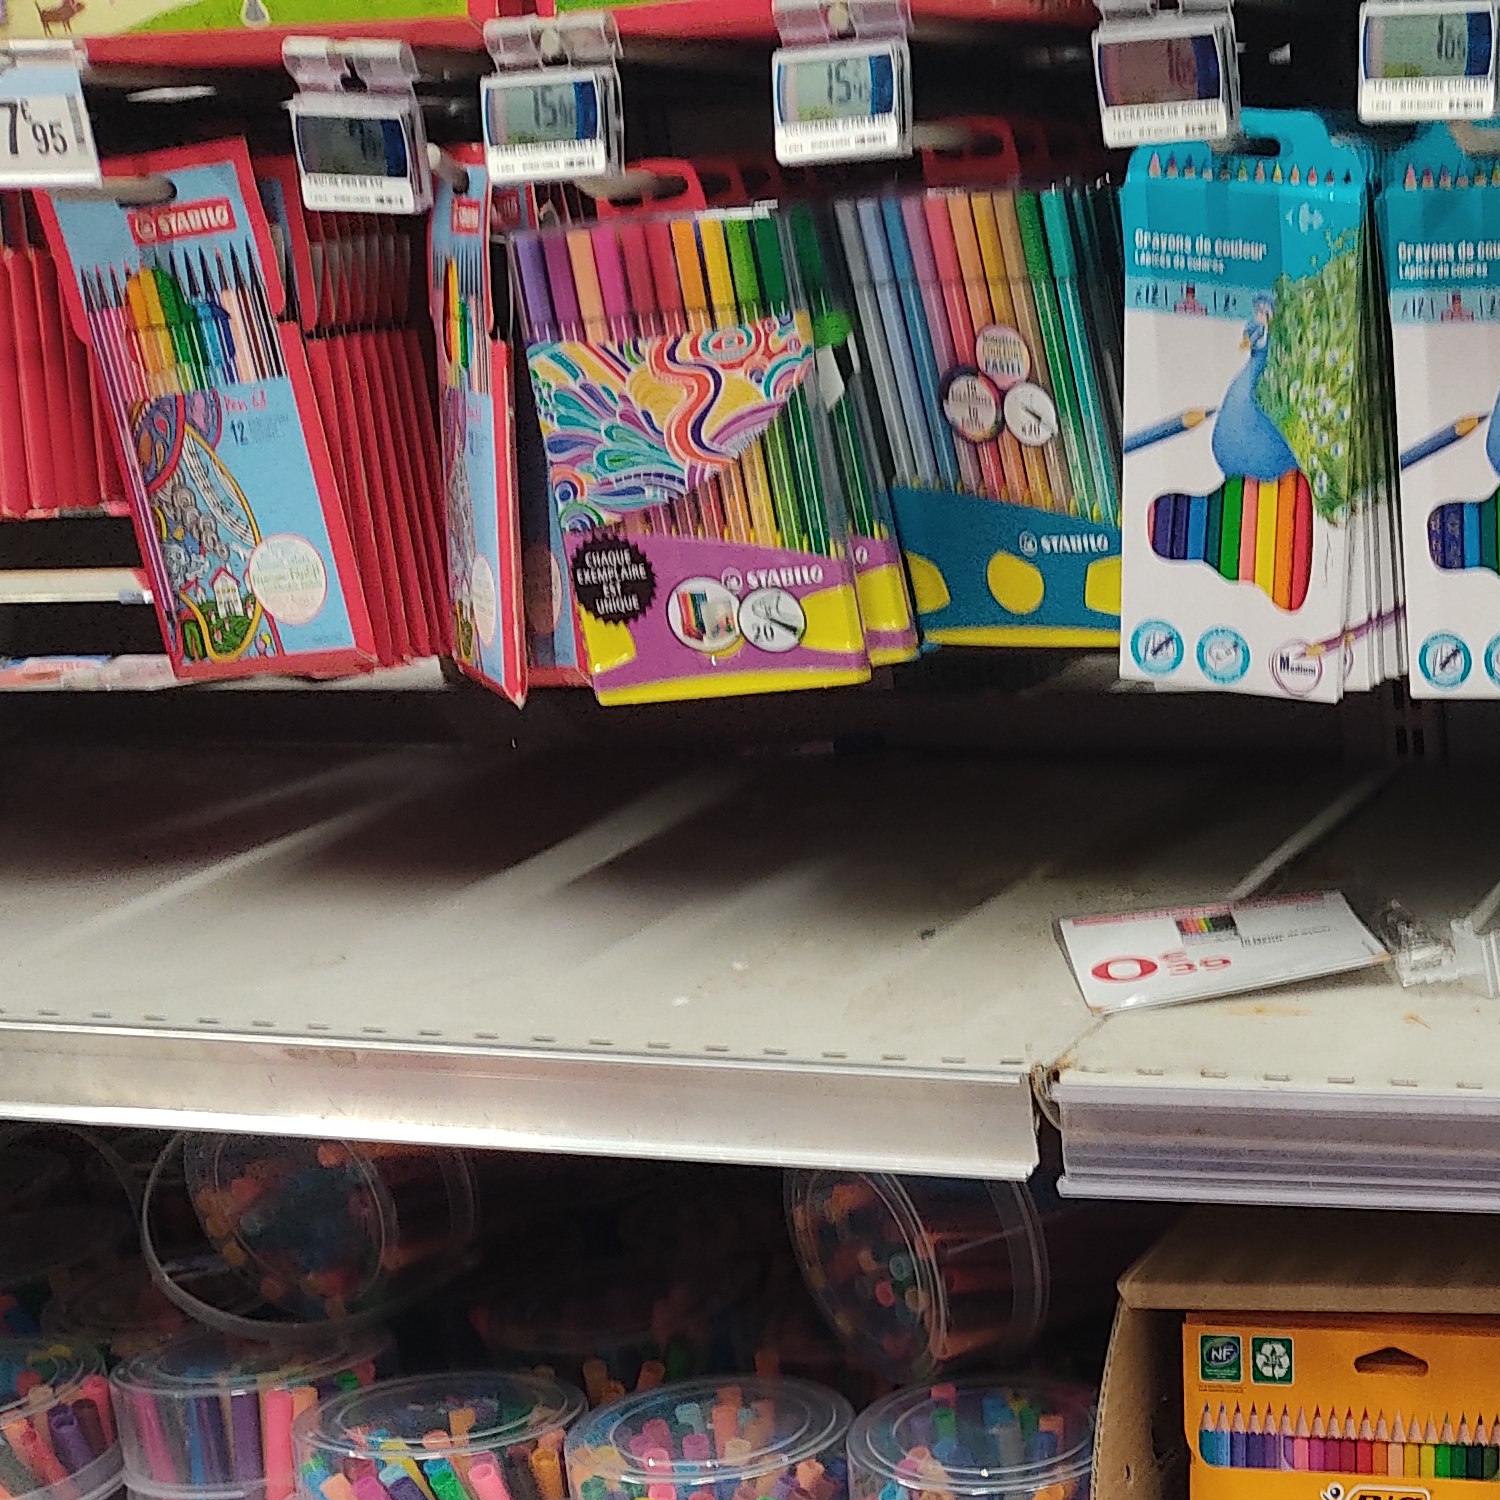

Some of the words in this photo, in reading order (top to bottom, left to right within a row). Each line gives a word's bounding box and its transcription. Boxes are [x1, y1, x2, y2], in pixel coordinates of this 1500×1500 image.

[230, 420, 249, 446] 12
[1041, 533, 1109, 554] STABILO
[584, 547, 632, 568] CHAQUE
[576, 562, 648, 586] EXEMPLAIRE
[747, 564, 824, 589] STABILO
[602, 581, 622, 597] EST
[595, 594, 640, 615] UNIQUE
[753, 623, 775, 642] 20
[1211, 1345, 1234, 1360] NF
